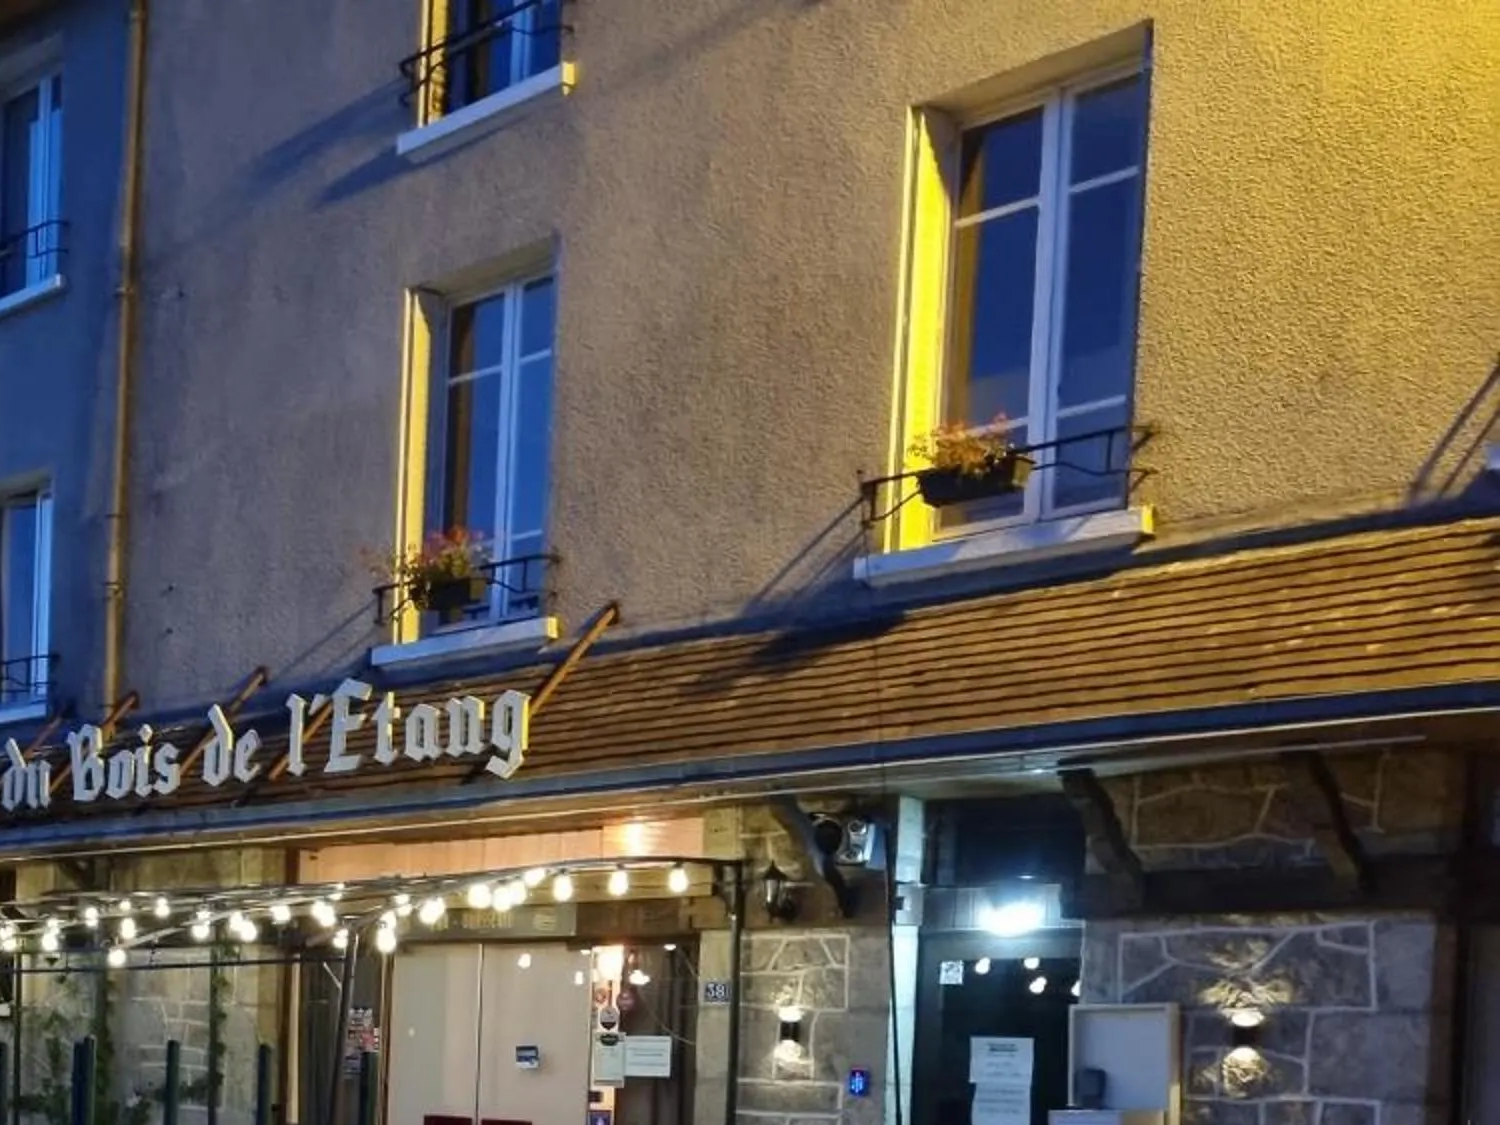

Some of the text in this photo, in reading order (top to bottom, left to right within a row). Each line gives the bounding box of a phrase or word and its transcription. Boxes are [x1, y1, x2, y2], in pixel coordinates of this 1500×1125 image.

[1, 737, 51, 812] du
[66, 723, 181, 801] Bois
[201, 703, 262, 788] de
[285, 677, 531, 780] l'Etang
